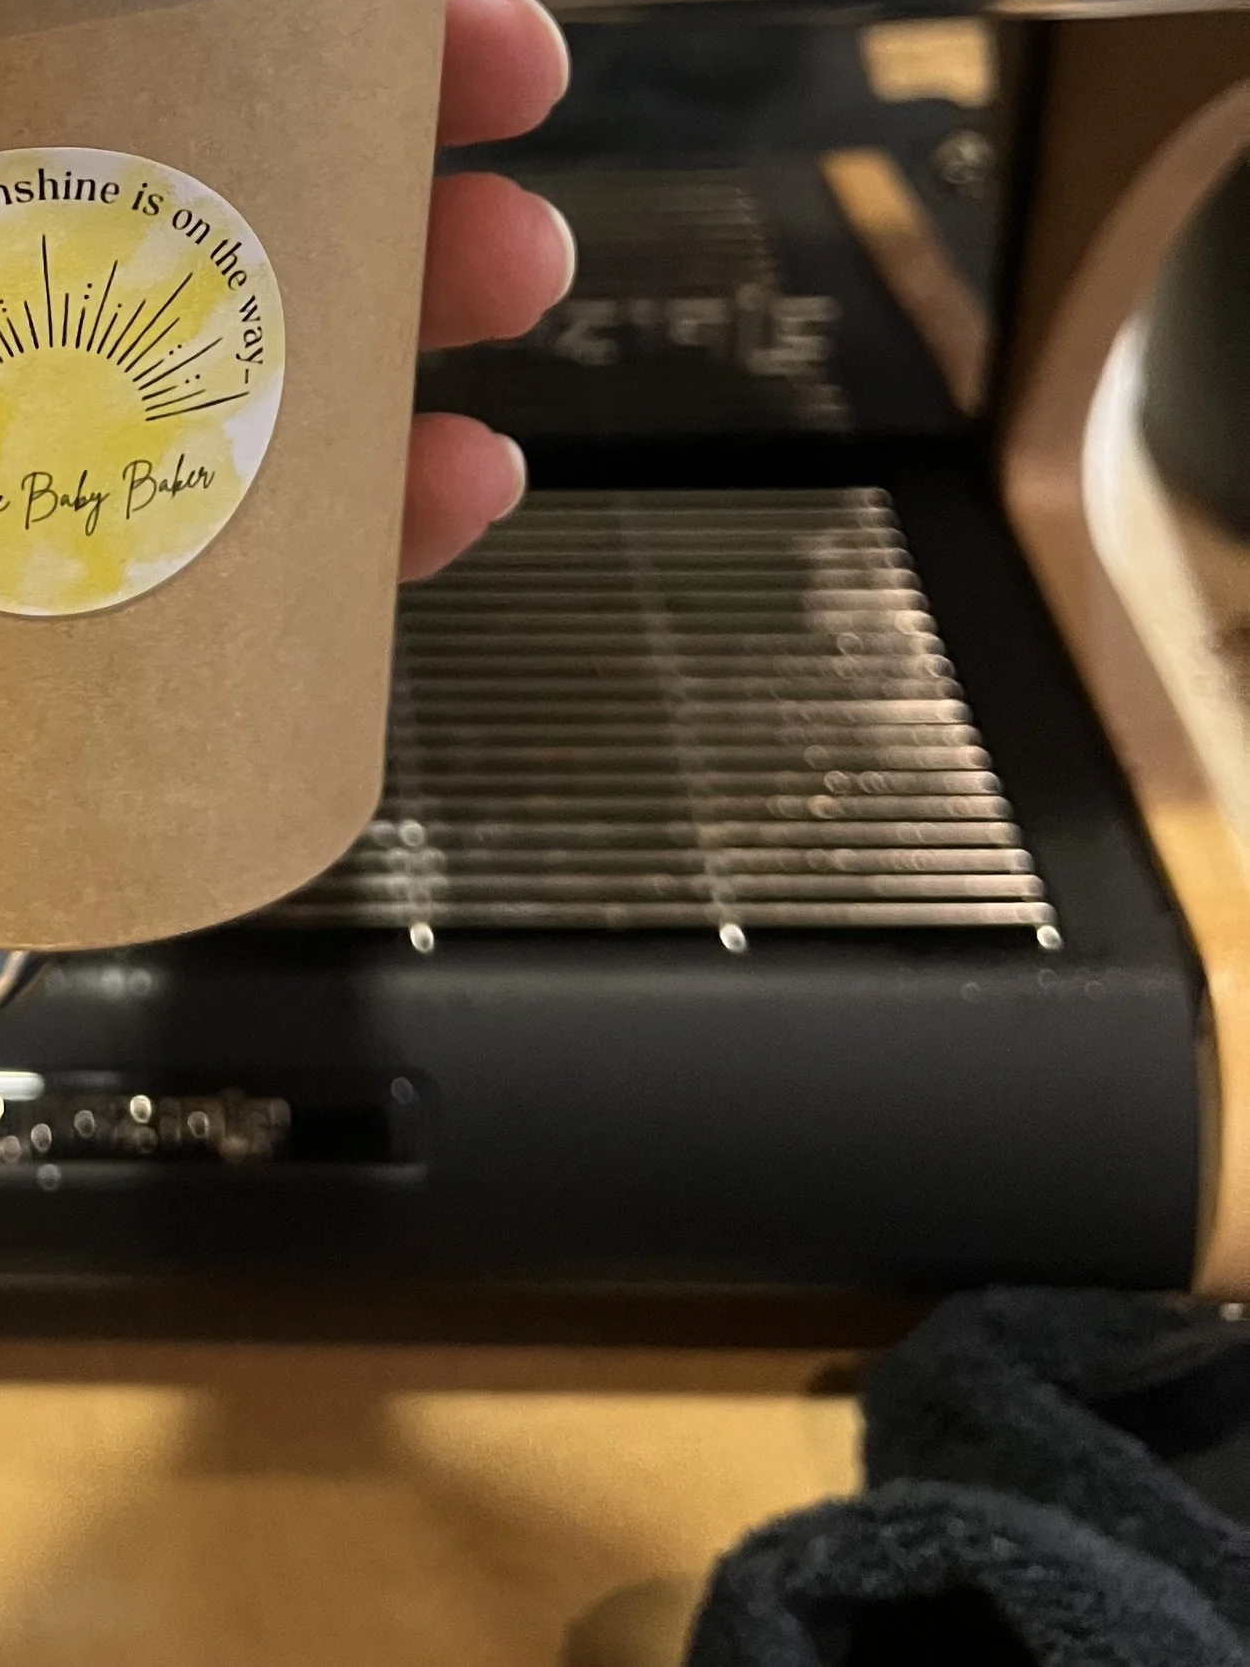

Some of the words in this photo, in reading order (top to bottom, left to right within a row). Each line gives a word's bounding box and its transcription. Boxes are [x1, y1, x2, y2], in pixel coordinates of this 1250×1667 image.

[131, 181, 165, 217] is
[172, 207, 212, 245] on
[210, 238, 248, 292] the
[20, 469, 111, 537] Baby
[122, 453, 216, 520] Baker
